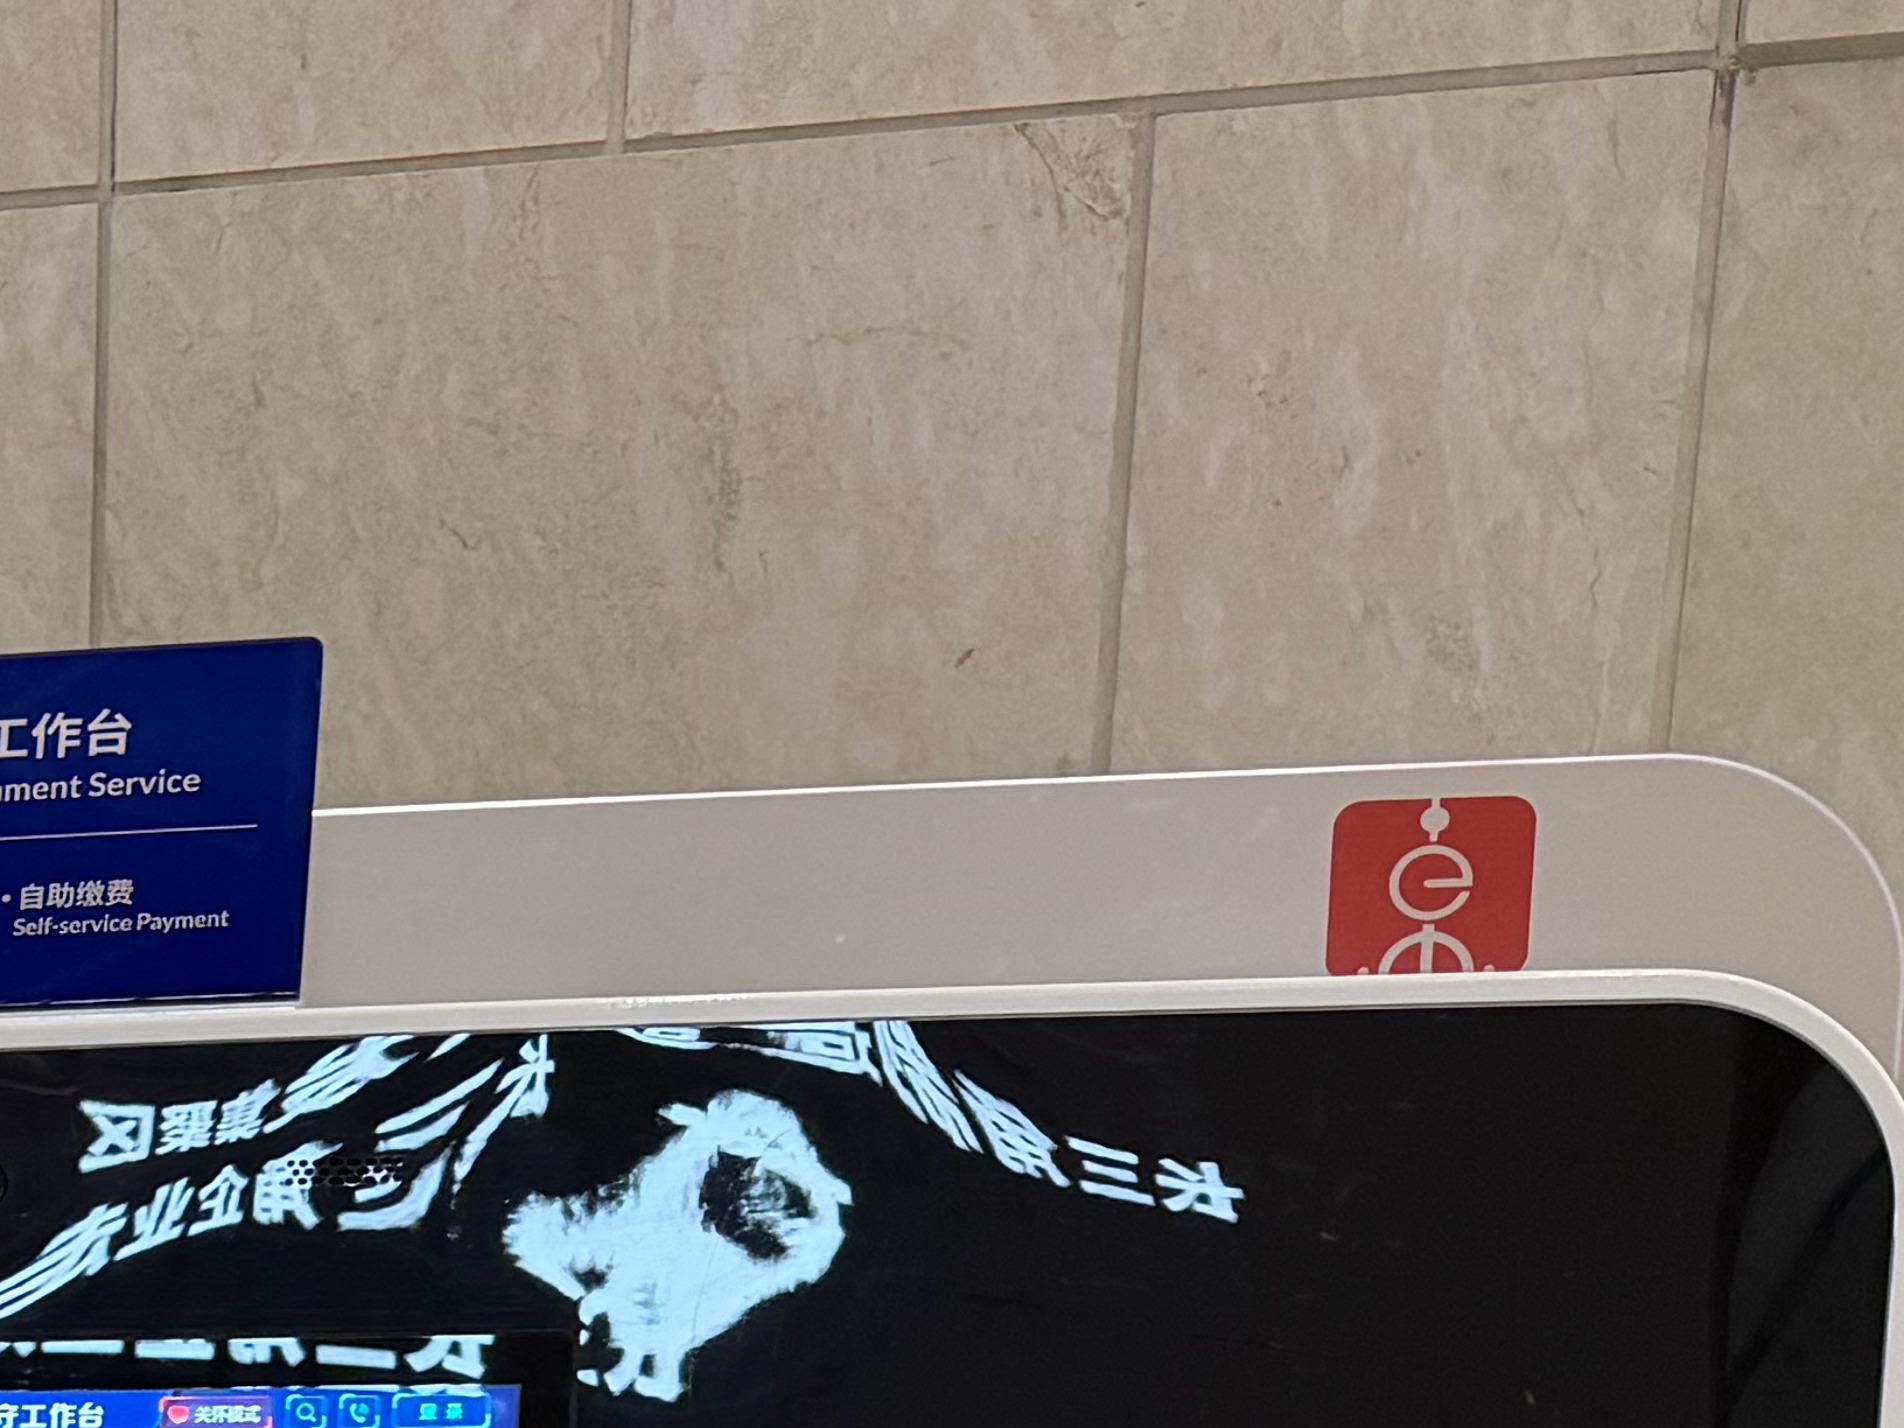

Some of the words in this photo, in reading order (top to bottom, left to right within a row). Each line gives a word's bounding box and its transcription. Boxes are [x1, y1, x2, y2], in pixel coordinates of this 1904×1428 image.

[88, 768, 202, 799] Service
[18, 878, 135, 911] 自助缴费
[12, 915, 133, 937] Self-service
[136, 909, 230, 933] Payment
[194, 1404, 262, 1425] 关怀模式
